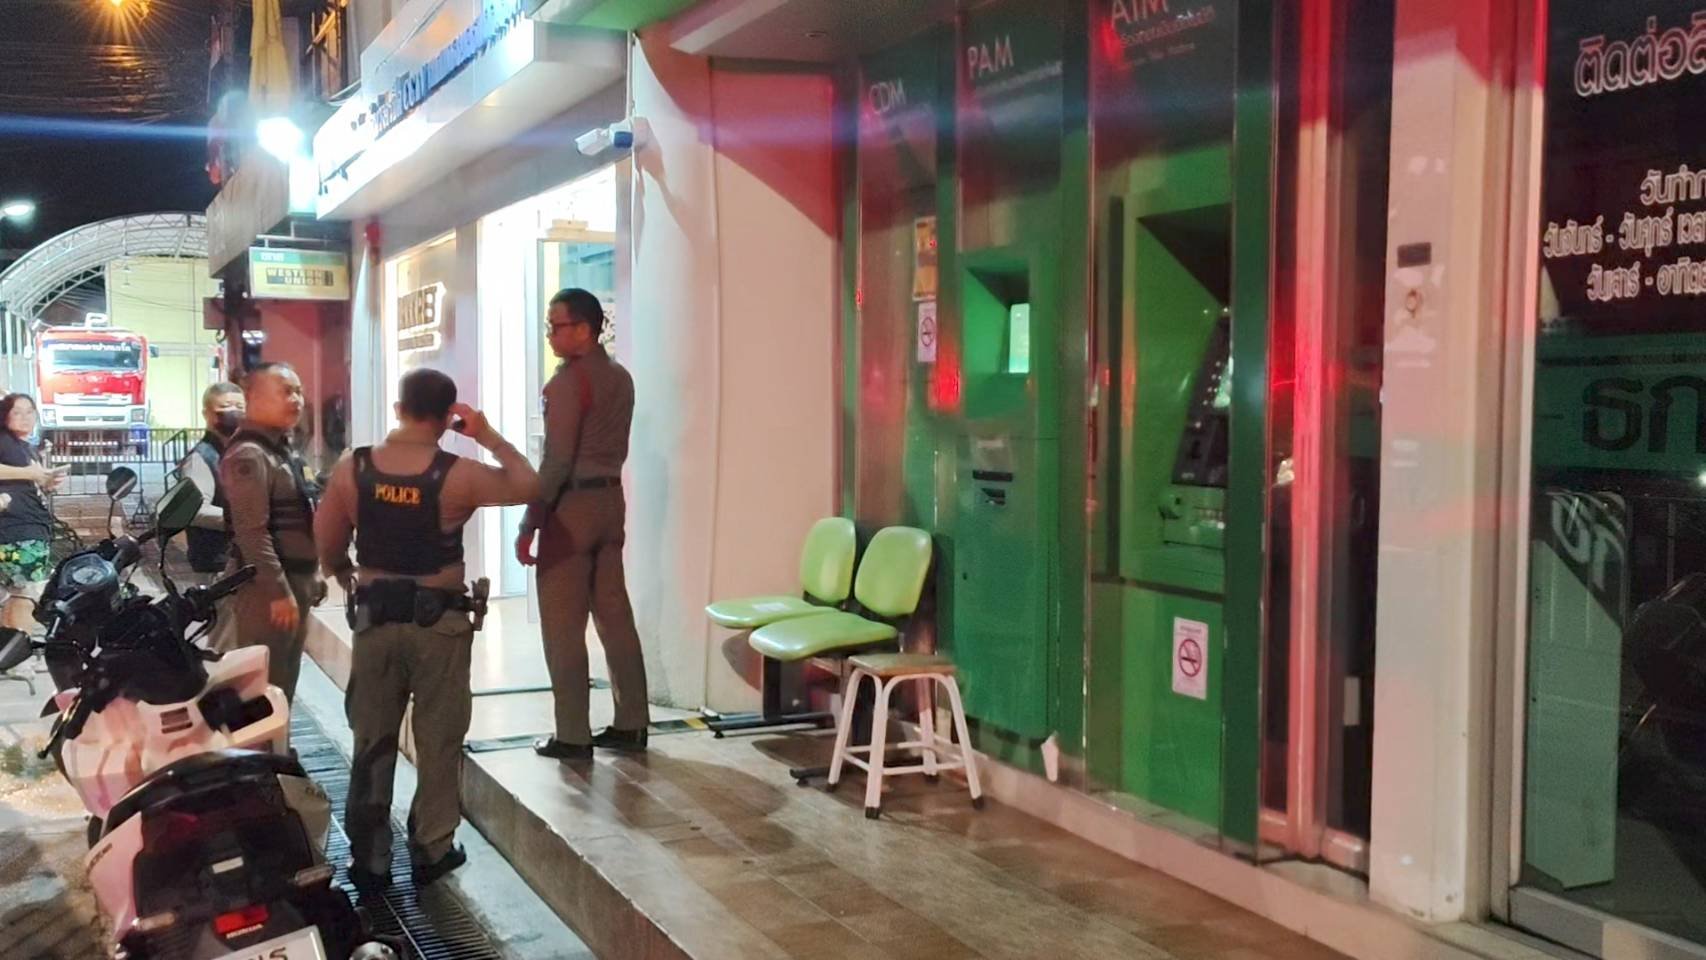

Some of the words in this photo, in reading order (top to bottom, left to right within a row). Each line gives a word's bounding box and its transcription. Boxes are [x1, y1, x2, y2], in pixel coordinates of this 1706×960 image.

[967, 35, 1014, 80] PAM
[868, 78, 907, 114] CDM
[375, 484, 420, 504] POLICE
